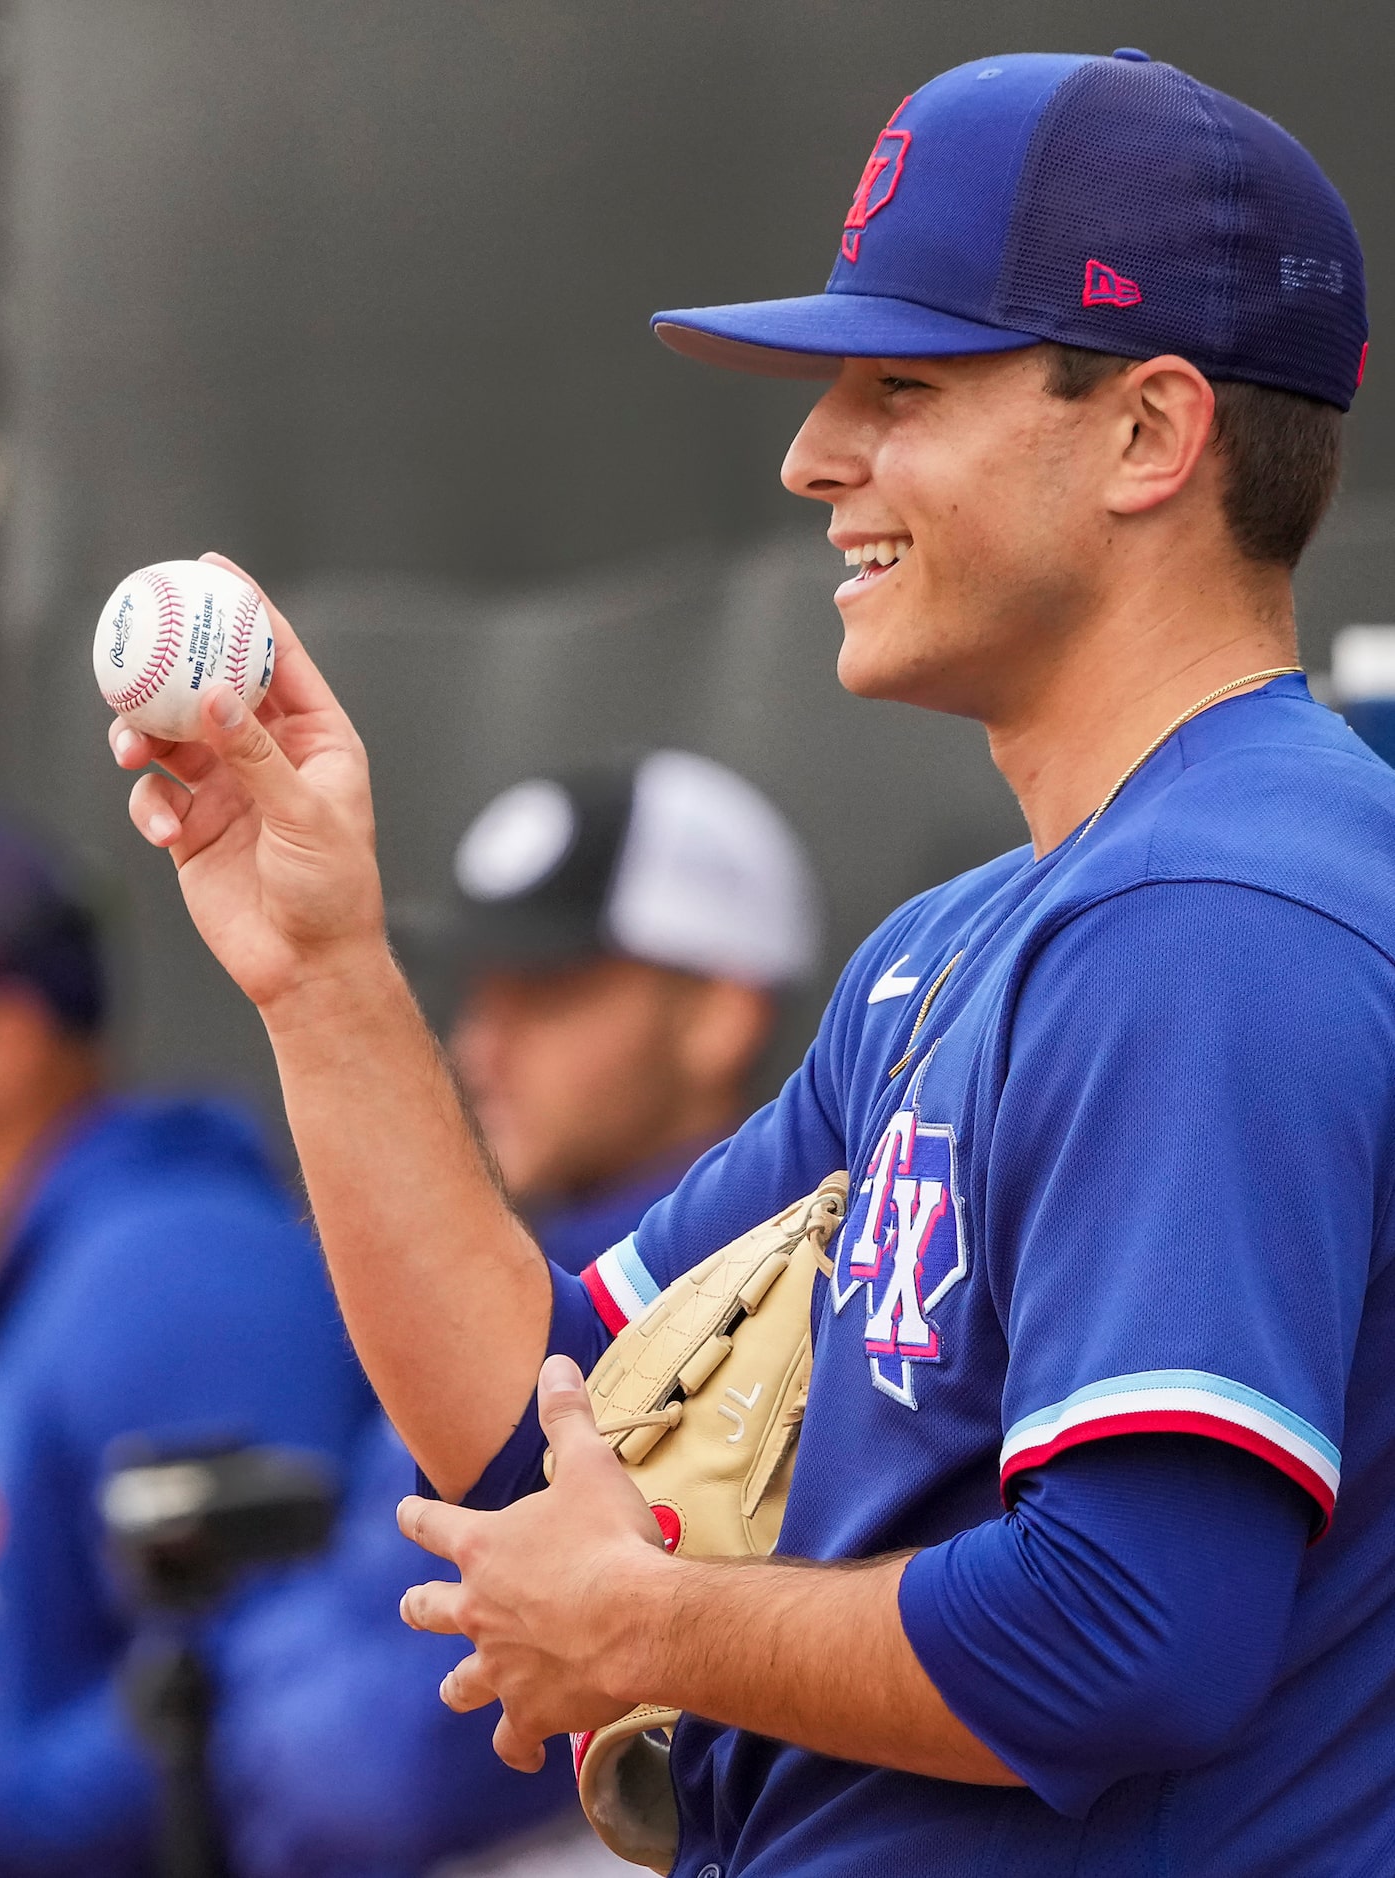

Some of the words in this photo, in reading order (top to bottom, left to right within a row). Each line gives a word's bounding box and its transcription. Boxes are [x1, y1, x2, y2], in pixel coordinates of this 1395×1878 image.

[202, 592, 213, 630] BASEBALL
[110, 593, 134, 669] Rawlings
[189, 623, 201, 654] OFFICIAL
[197, 631, 211, 660] LEAGUE
[190, 661, 205, 690] MAJOR
[717, 1382, 763, 1444] JL
